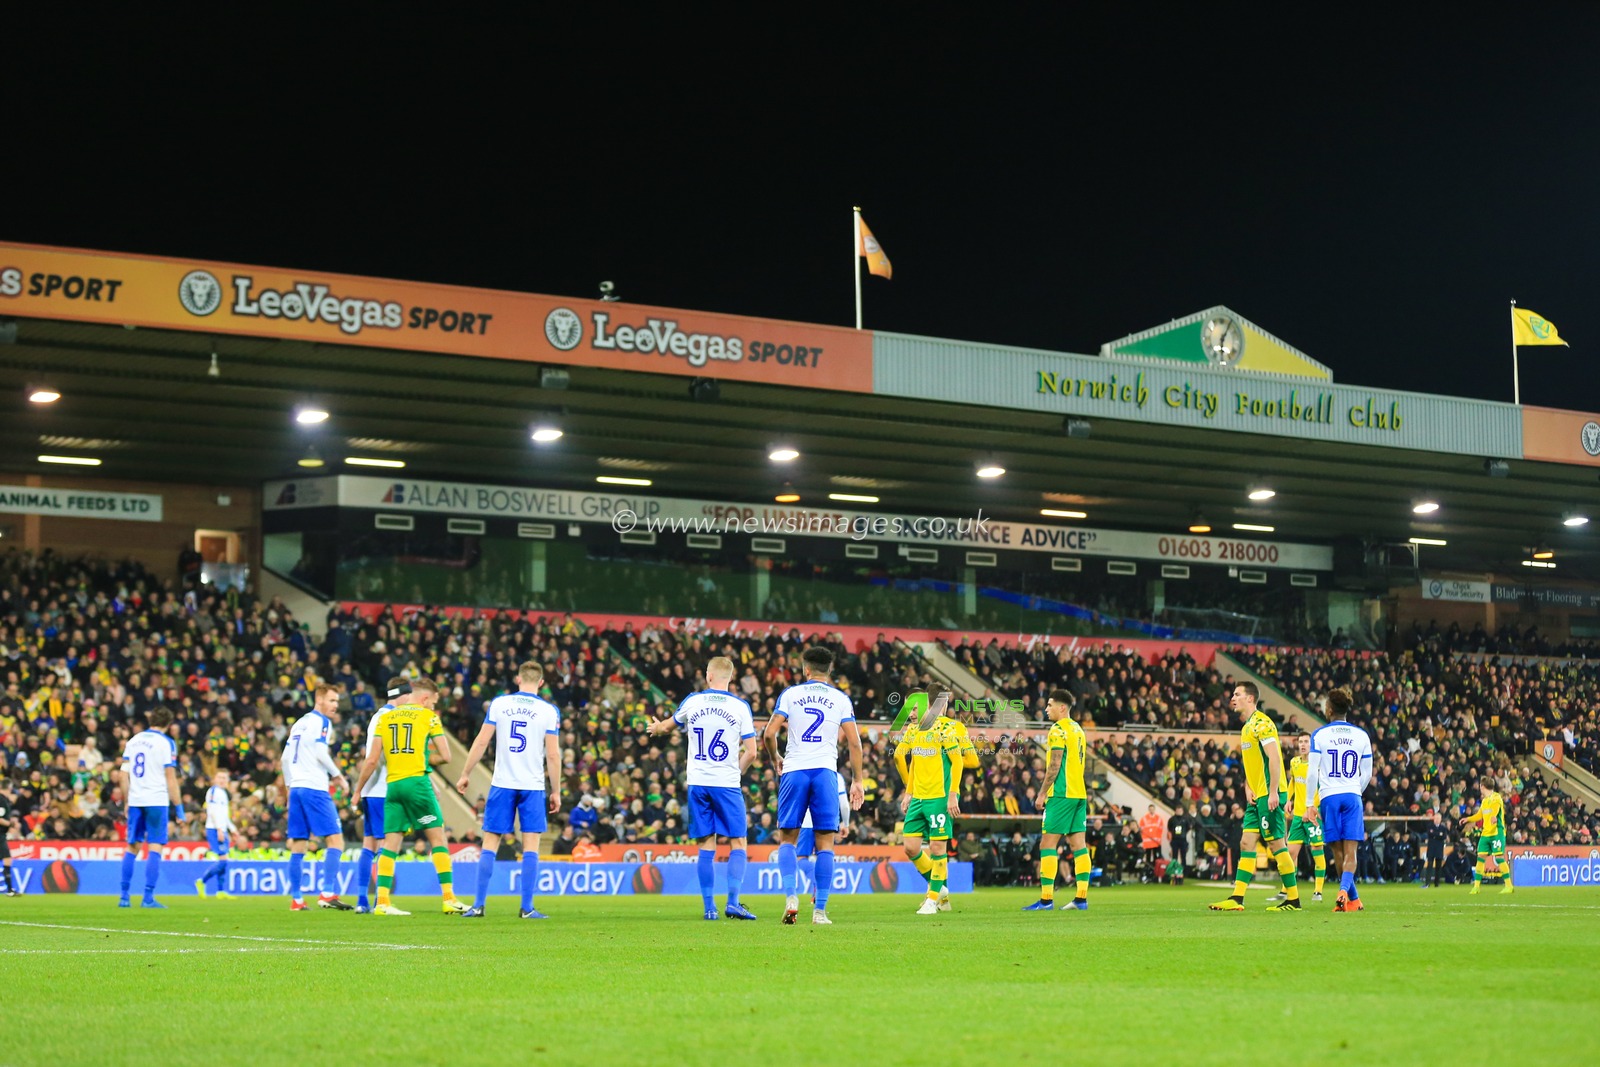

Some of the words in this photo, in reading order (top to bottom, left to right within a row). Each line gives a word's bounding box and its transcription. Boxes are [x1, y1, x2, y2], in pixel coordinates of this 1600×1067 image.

[28, 272, 122, 302] SPORT
[232, 276, 403, 334] LeoVegas
[408, 306, 493, 335] SPORT
[592, 312, 743, 367] LeoVegas
[748, 340, 824, 368] SPORT
[1037, 370, 1149, 409] Norwich
[1165, 380, 1219, 418] City
[1236, 389, 1334, 424] Football
[1349, 397, 1403, 431] Club
[0, 491, 62, 509] ANIMAL
[67, 495, 116, 512] FEEDS
[122, 497, 150, 513] LTD
[408, 484, 468, 508] ALAN
[476, 488, 576, 516] BOSWELL
[581, 496, 661, 520] GROUP
[896, 518, 1010, 544] INSURANCE
[1158, 536, 1211, 558] 01603
[1218, 540, 1278, 563] 218000
[1452, 581, 1471, 591] Check
[1459, 589, 1485, 601] Security
[1546, 589, 1582, 607] Flooring
[505, 707, 538, 720] CLARKE
[797, 695, 835, 710] WALKES
[688, 707, 738, 727] WHATMOUGH
[801, 707, 825, 742] 2
[388, 723, 415, 754] 11
[509, 720, 528, 753] 5
[693, 727, 730, 762] 16
[1333, 737, 1354, 747] LOWE
[291, 734, 302, 764] 7
[133, 752, 145, 778] 8
[1326, 749, 1359, 779] 10
[929, 813, 946, 829] 19
[1261, 815, 1270, 830] 6
[1308, 825, 1322, 838] 36
[1492, 840, 1502, 849] 24
